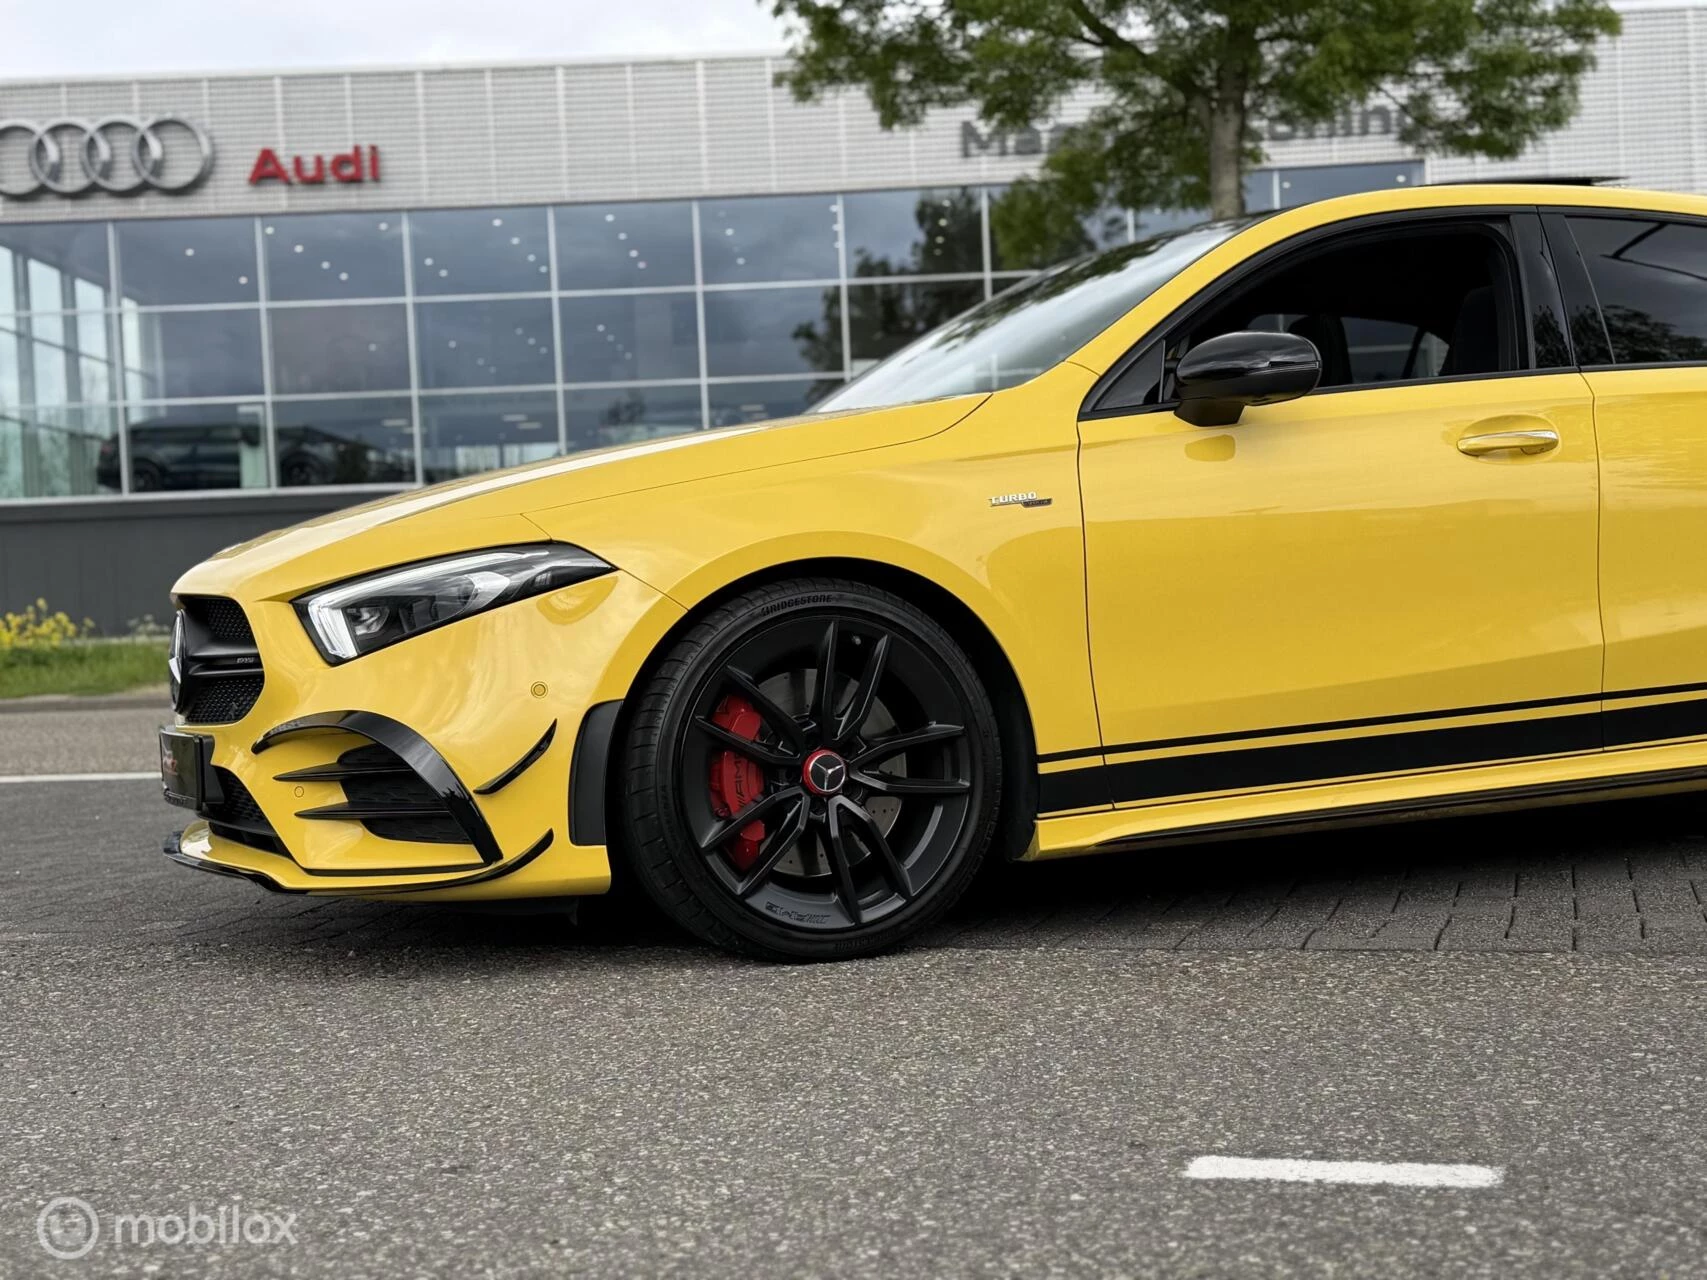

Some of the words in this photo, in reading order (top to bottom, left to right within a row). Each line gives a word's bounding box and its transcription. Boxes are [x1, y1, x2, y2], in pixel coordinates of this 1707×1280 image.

[248, 144, 380, 185] Audi
[990, 491, 1037, 505] TURBO
[761, 594, 833, 617] BRIDGESTONE
